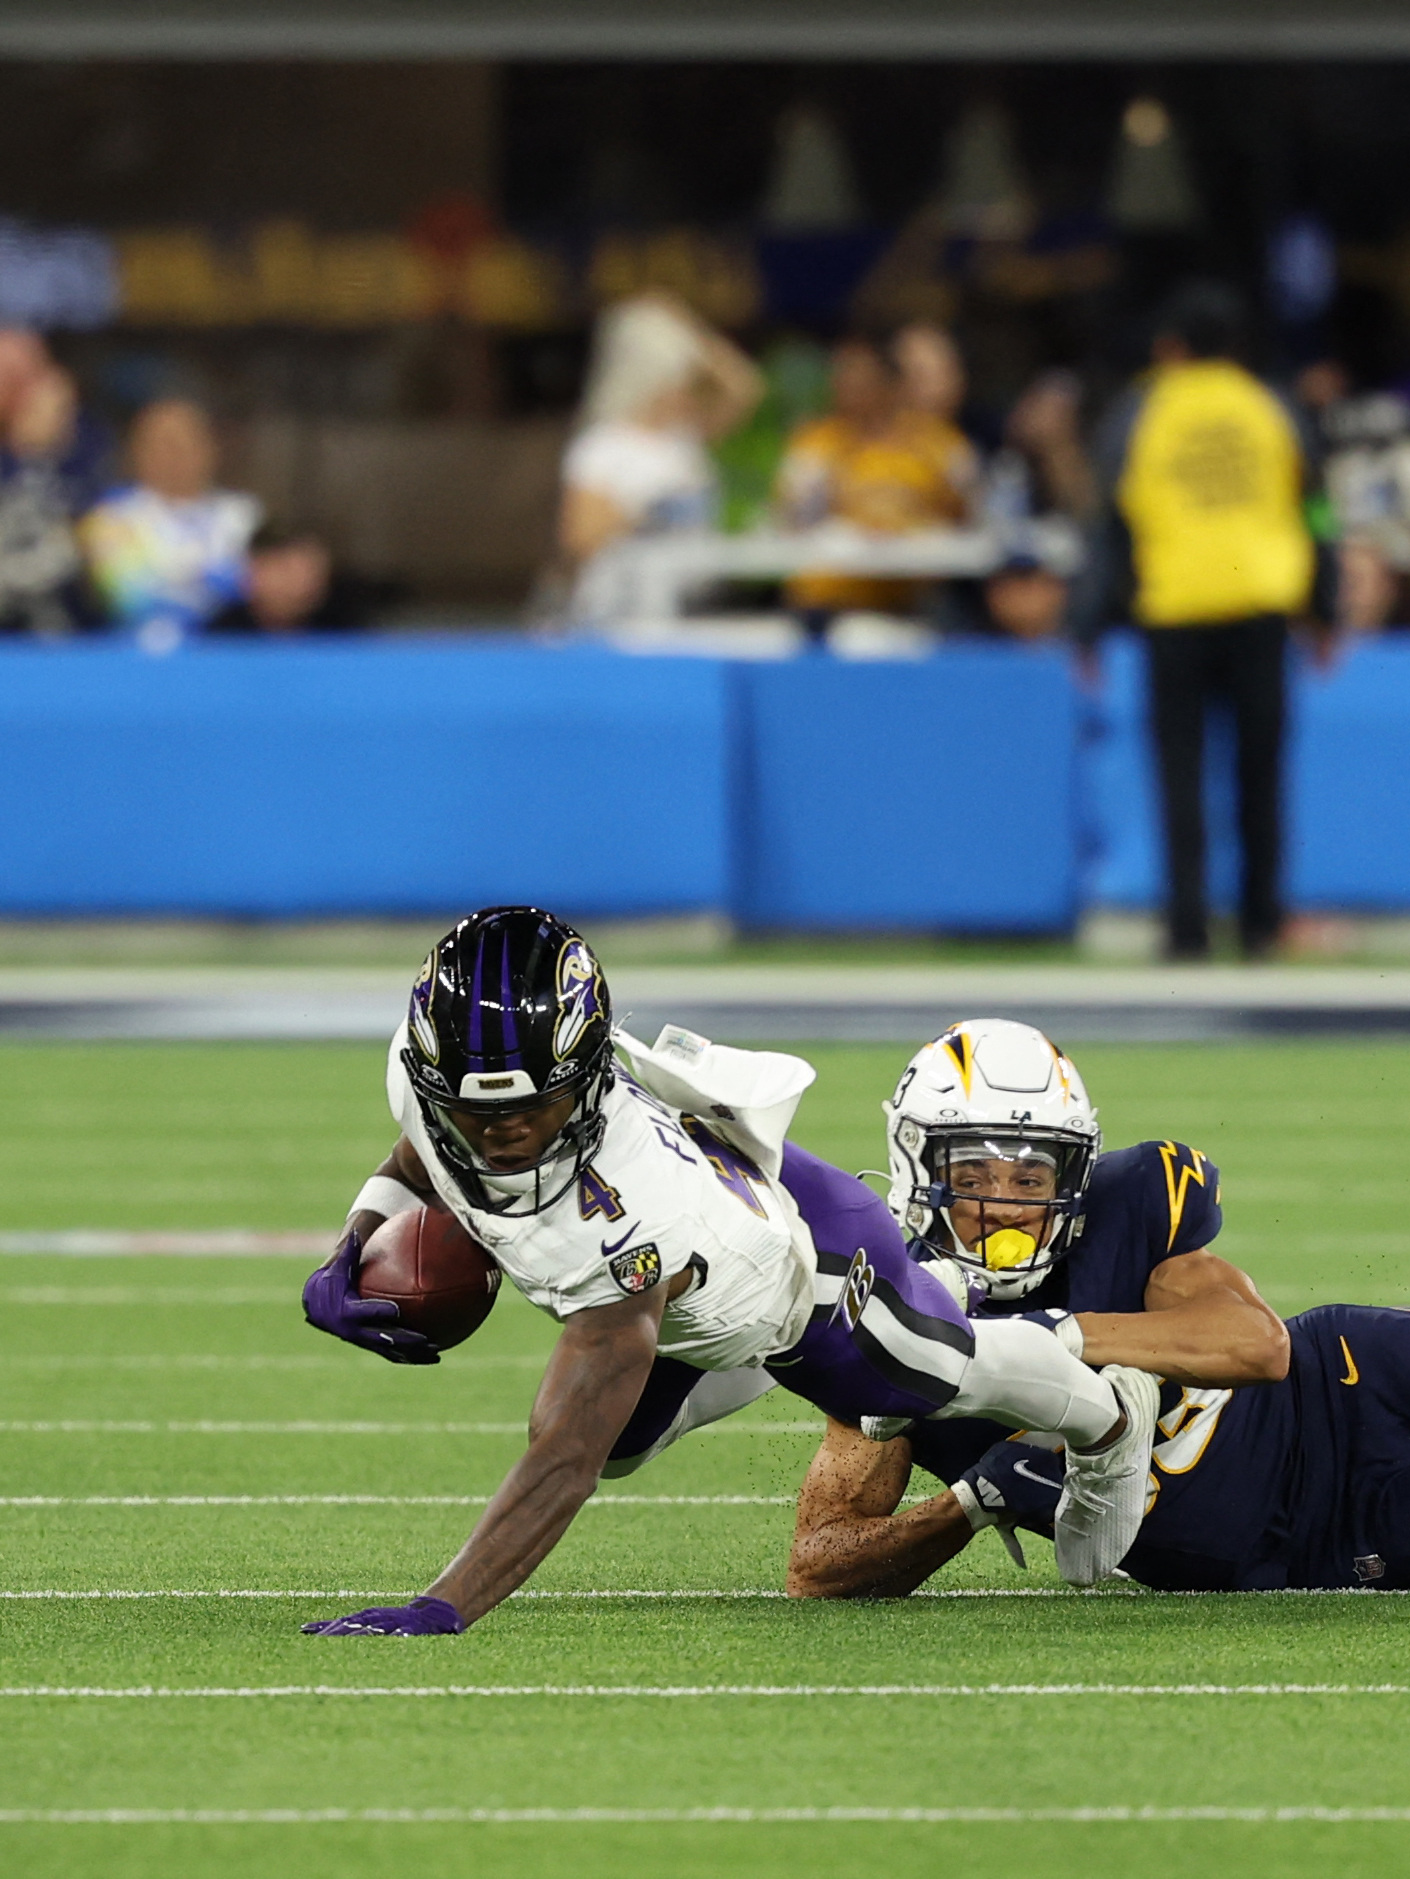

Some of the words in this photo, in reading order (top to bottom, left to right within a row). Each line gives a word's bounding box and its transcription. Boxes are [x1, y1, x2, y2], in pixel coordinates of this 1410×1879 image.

[1010, 1109, 1032, 1122] LA
[577, 1163, 627, 1223] 4
[612, 1245, 653, 1266] RAVENS
